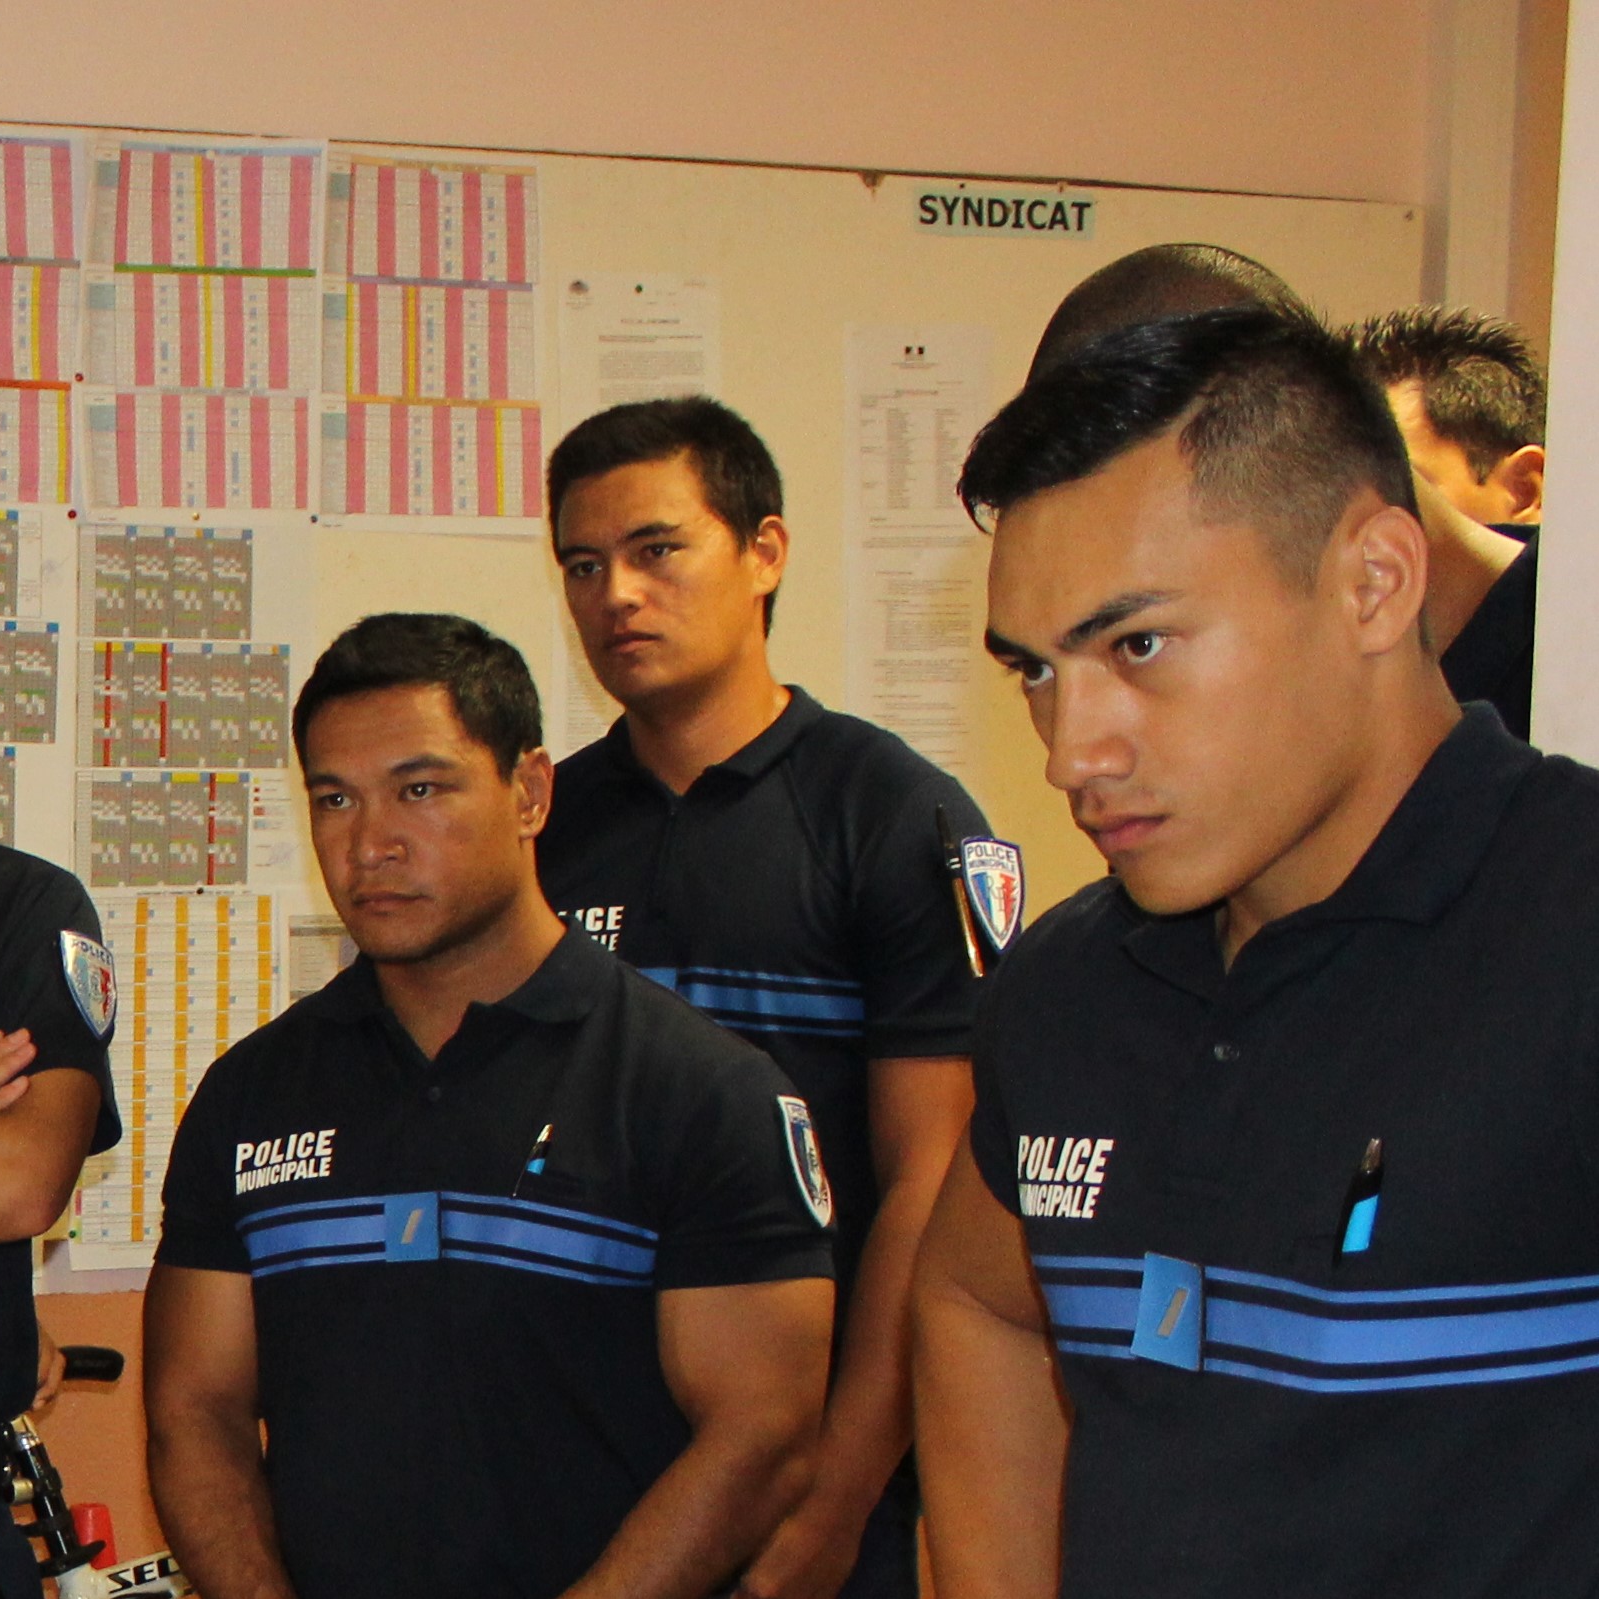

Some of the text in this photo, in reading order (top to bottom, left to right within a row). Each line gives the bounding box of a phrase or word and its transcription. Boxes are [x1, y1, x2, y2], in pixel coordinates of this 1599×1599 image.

[919, 194, 1092, 232] SYNDICAT
[966, 844, 1016, 865] POLICE
[235, 1128, 337, 1173] POLICE
[1017, 1134, 1115, 1184] POLICE
[235, 1156, 332, 1196] MUNICIPALE
